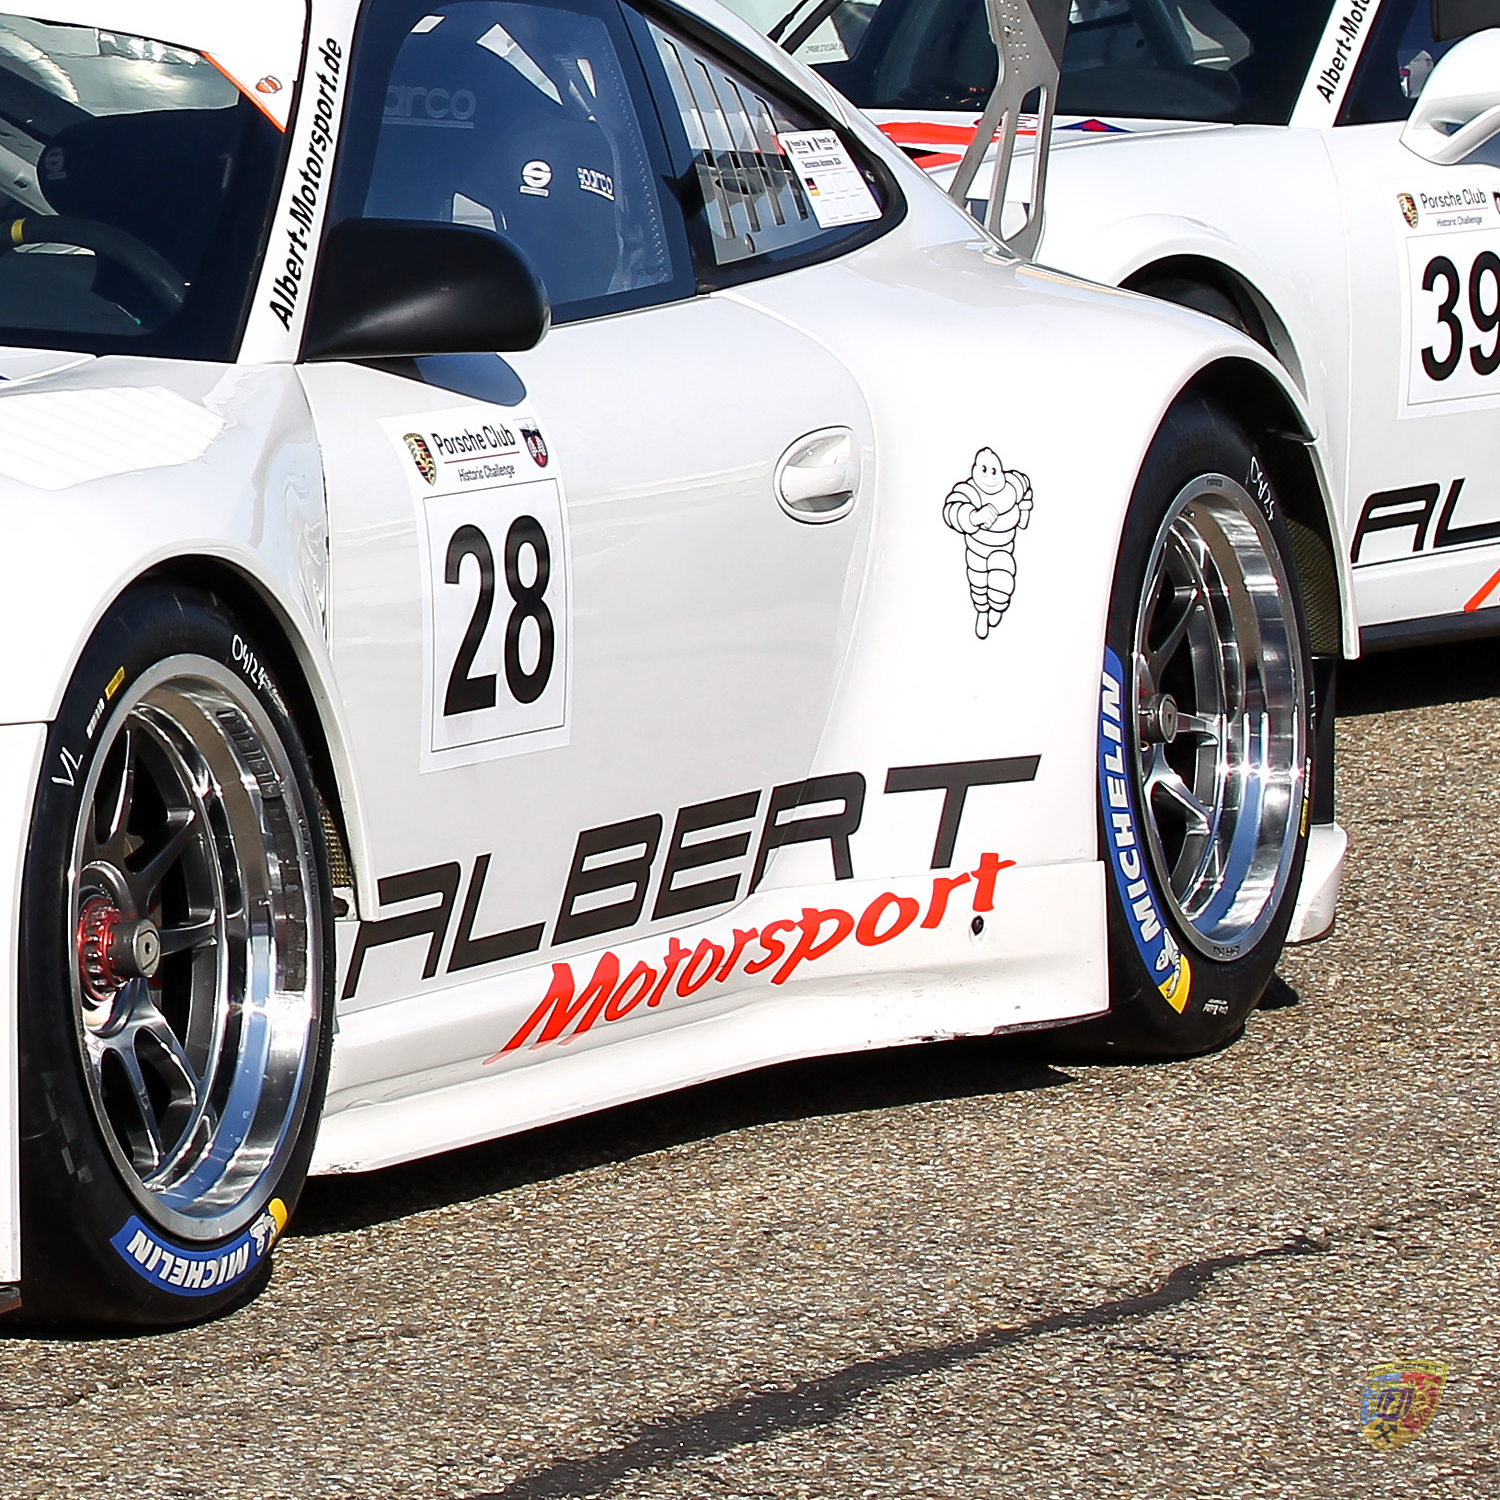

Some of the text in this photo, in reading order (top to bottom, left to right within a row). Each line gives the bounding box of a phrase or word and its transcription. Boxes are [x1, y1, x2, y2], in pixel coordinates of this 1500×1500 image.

[269, 36, 343, 332] Albert-Motorsport.de
[1420, 187, 1487, 209] Porsche Club
[1419, 250, 1500, 382] 39
[431, 423, 516, 456] Porsche Club
[459, 464, 516, 483] Historic Challenge
[443, 514, 555, 717] 28
[341, 754, 1043, 1000] ALBERT
[1100, 671, 1161, 943] MICHELIN
[483, 852, 1016, 1066] Motorsport
[126, 1229, 250, 1289] MICHELIN
